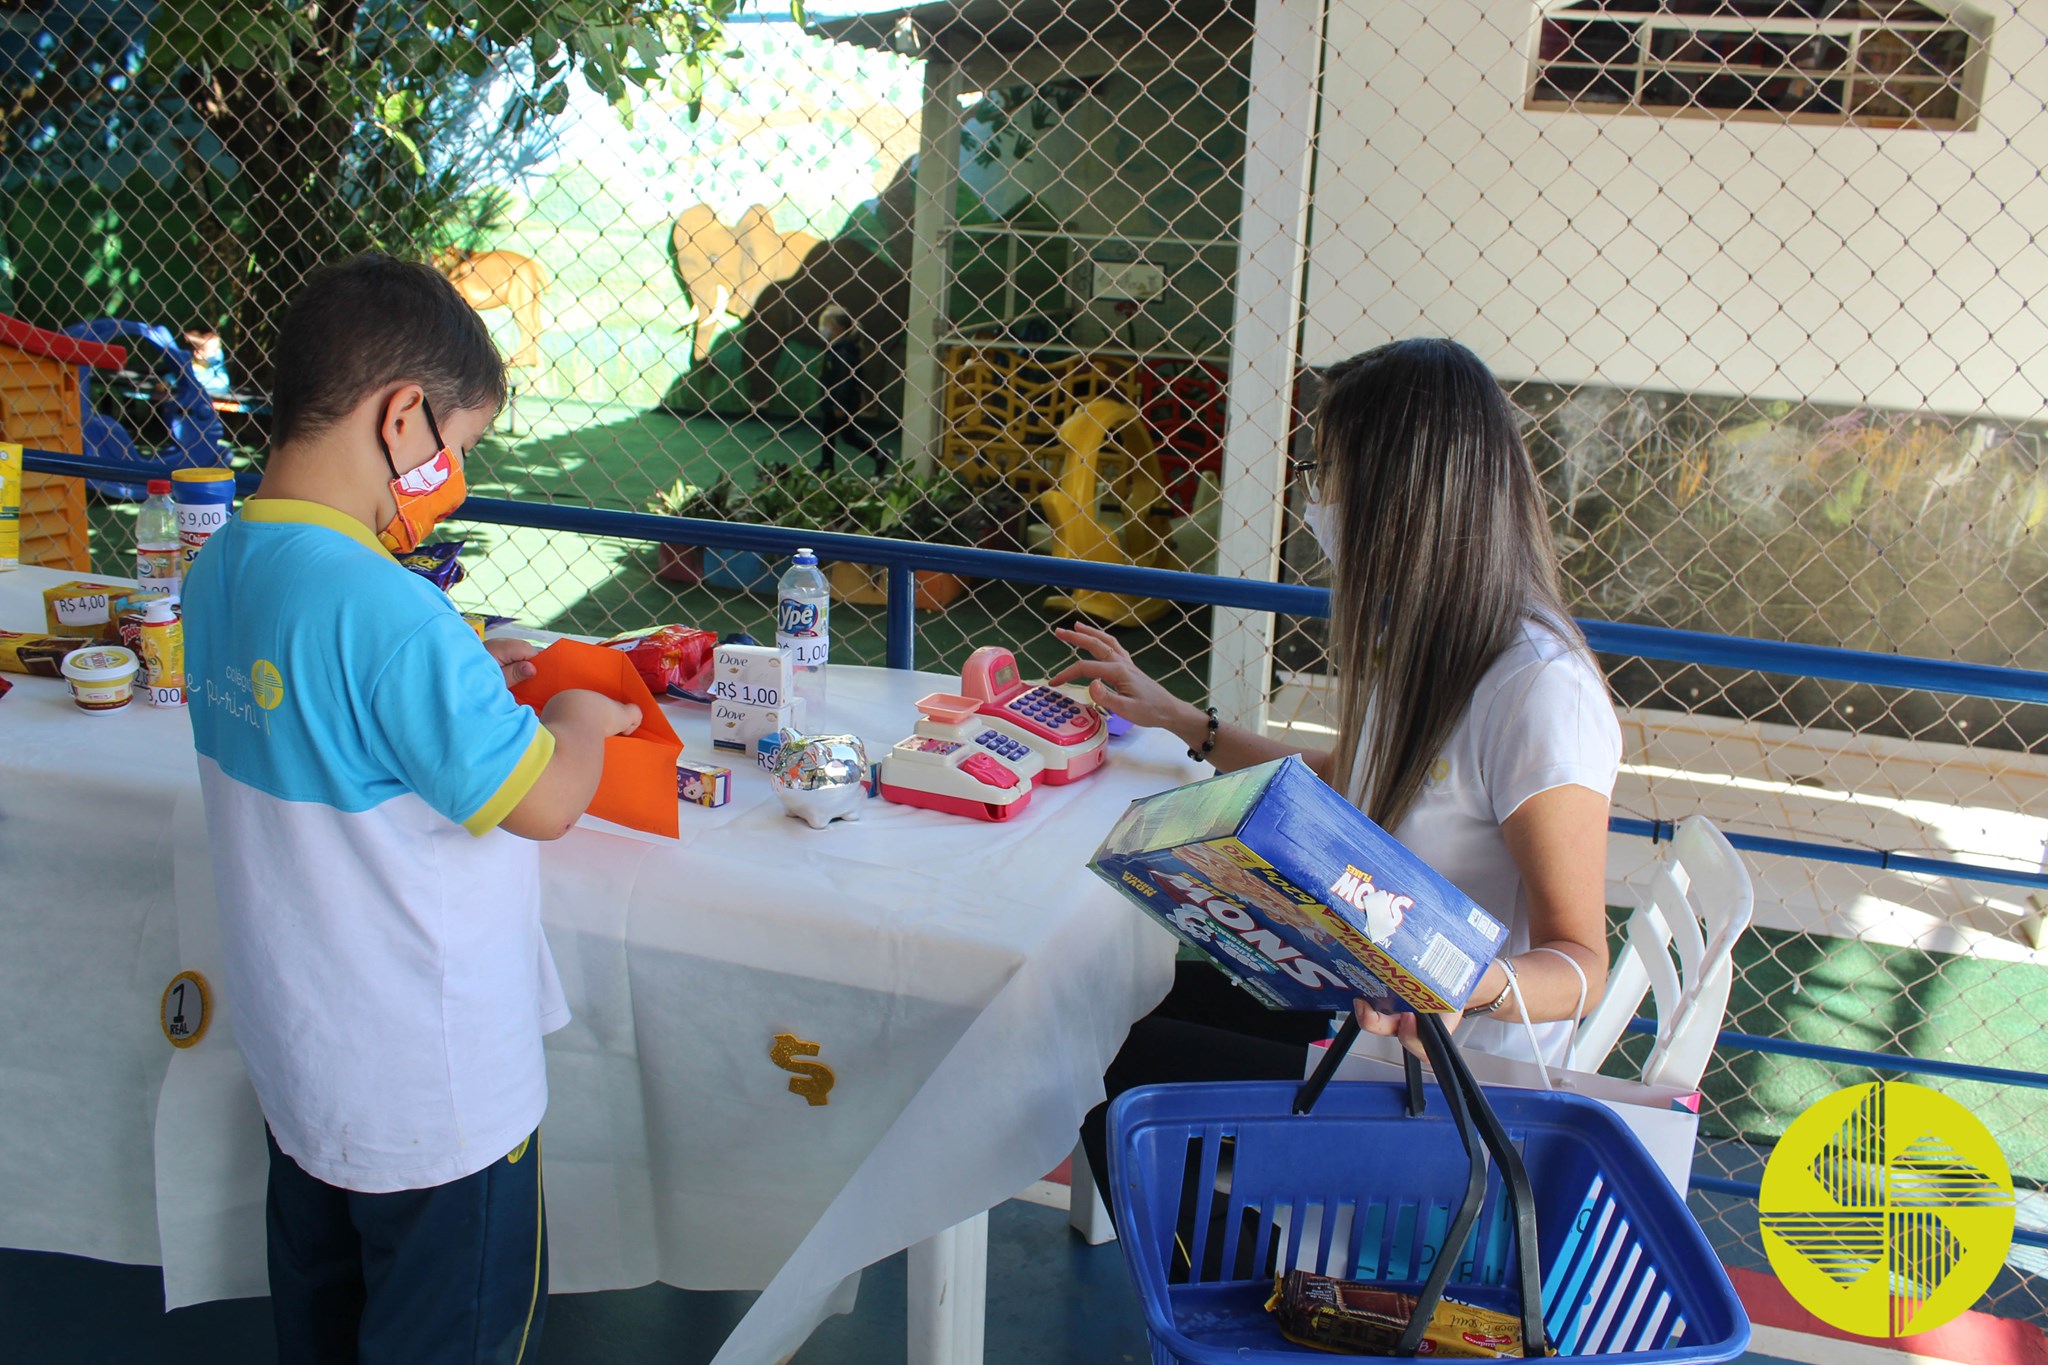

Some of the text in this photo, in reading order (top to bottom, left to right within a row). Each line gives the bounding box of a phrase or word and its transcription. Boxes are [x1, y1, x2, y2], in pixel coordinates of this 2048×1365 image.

[188, 511, 221, 528] 9,00
[59, 594, 106, 613] R$ 4,00
[719, 653, 748, 667] Dove
[796, 643, 827, 664] 1,00
[717, 681, 778, 705] R$ 1,00
[716, 706, 745, 721] Dove
[1345, 864, 1373, 884] FLAKES
[1121, 873, 1154, 898] NOVA
[1179, 872, 1246, 909] FLAKES
[1262, 869, 1317, 904] 620g
[1329, 871, 1414, 929] SOW
[1149, 869, 1349, 988] SNOW
[1337, 935, 1428, 1011] EMBALAGEM
[169, 1022, 190, 1036] REAL
